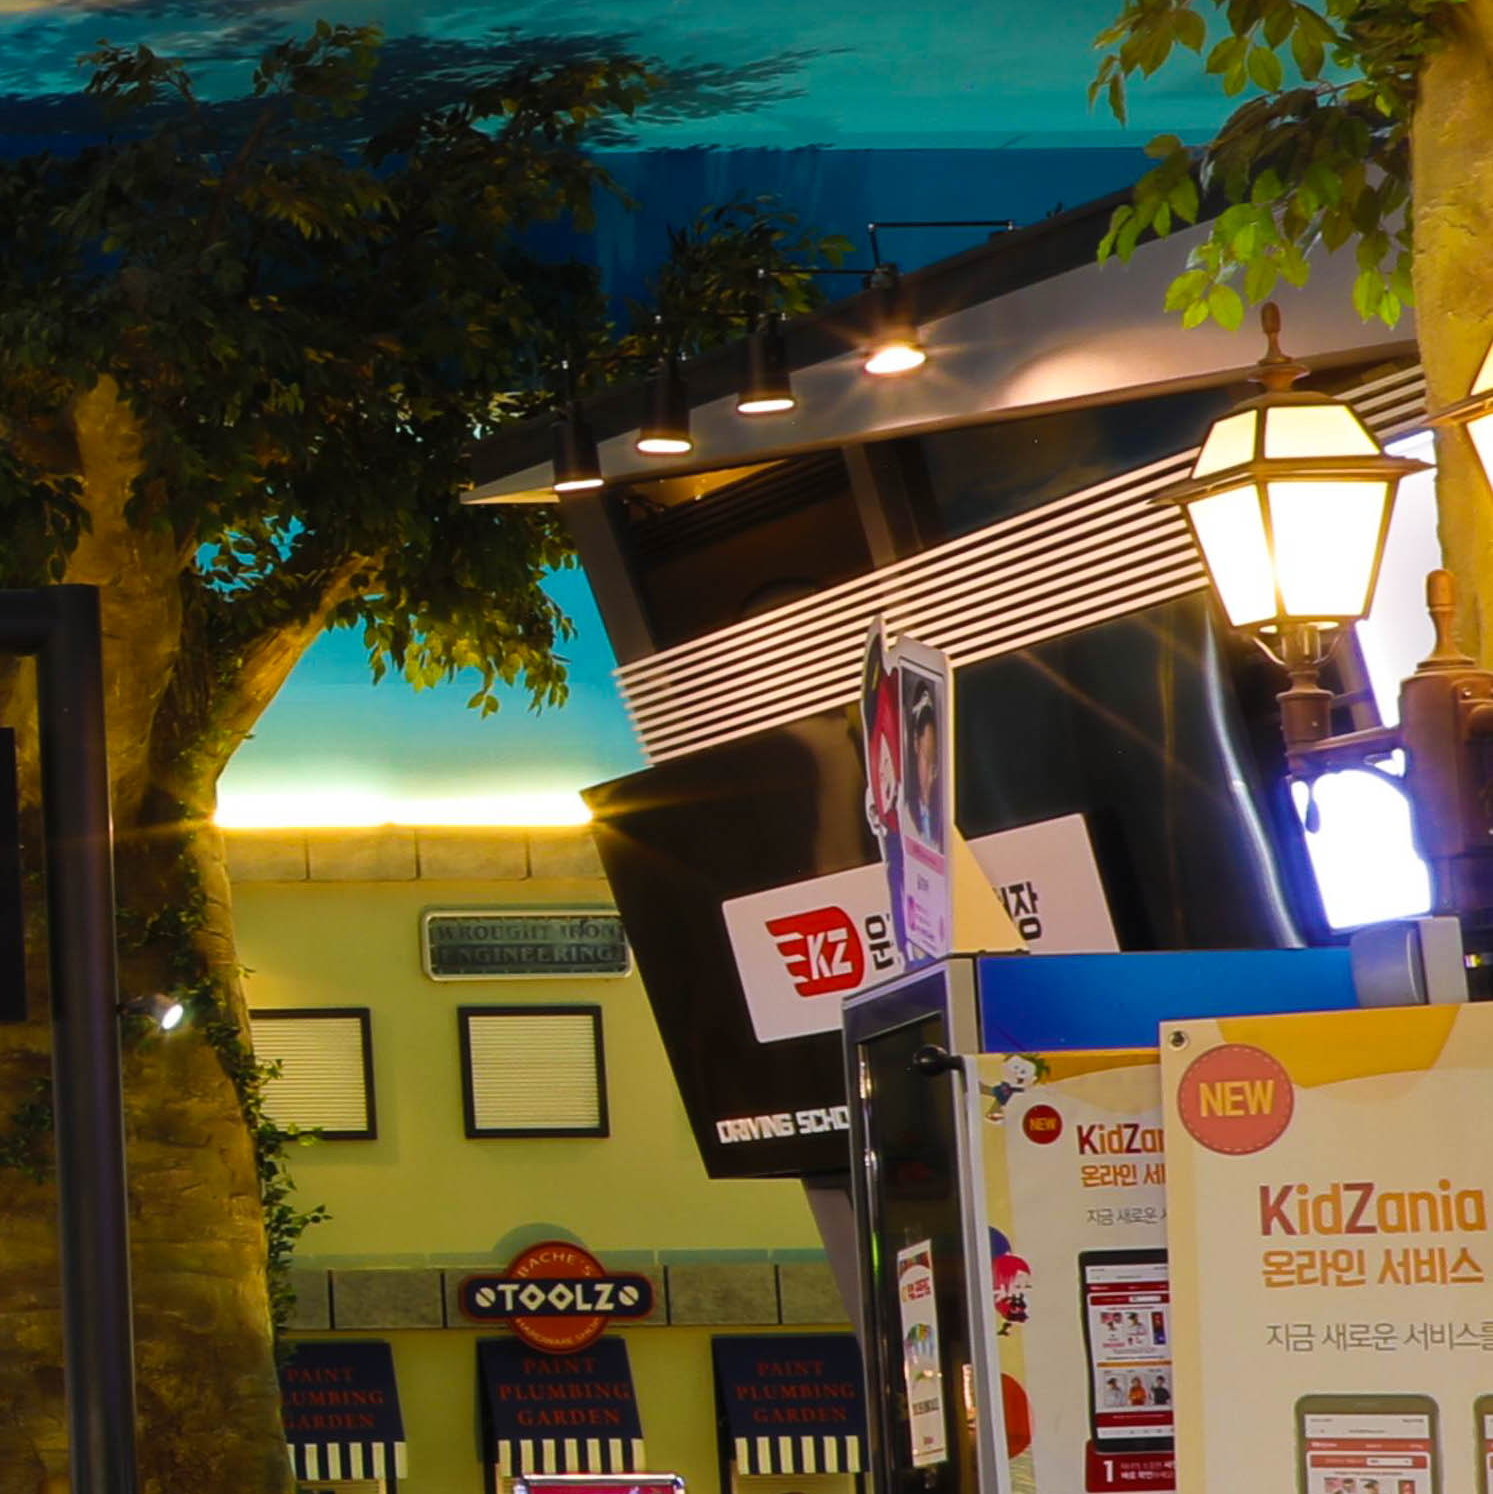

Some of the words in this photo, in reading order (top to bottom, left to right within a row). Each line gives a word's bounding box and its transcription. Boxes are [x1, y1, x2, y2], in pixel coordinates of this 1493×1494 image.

[805, 927, 854, 981] KZ
[1199, 1079, 1275, 1118] NEW
[715, 1112, 796, 1144] DRIVING
[1029, 1117, 1057, 1131] NEW
[1081, 1163, 1138, 1188] 온라인
[1087, 1208, 1114, 1227] 지금
[1116, 1206, 1159, 1225] 새로운
[1259, 1178, 1487, 1237] KidZania
[1261, 1248, 1367, 1289] 온라인
[1376, 1246, 1485, 1286] 서비스
[496, 1282, 615, 1311] TOOLZ
[1266, 1322, 1317, 1352] 지금
[1321, 1322, 1399, 1352] 새로운
[523, 1357, 599, 1376] PAINT
[756, 1361, 825, 1378] PAINT
[498, 1383, 633, 1402] PLUMBING
[735, 1383, 856, 1401] PLUMBING
[518, 1410, 621, 1427] GARDEN
[753, 1406, 848, 1423] GARDEN
[1103, 1459, 1115, 1483] 1
